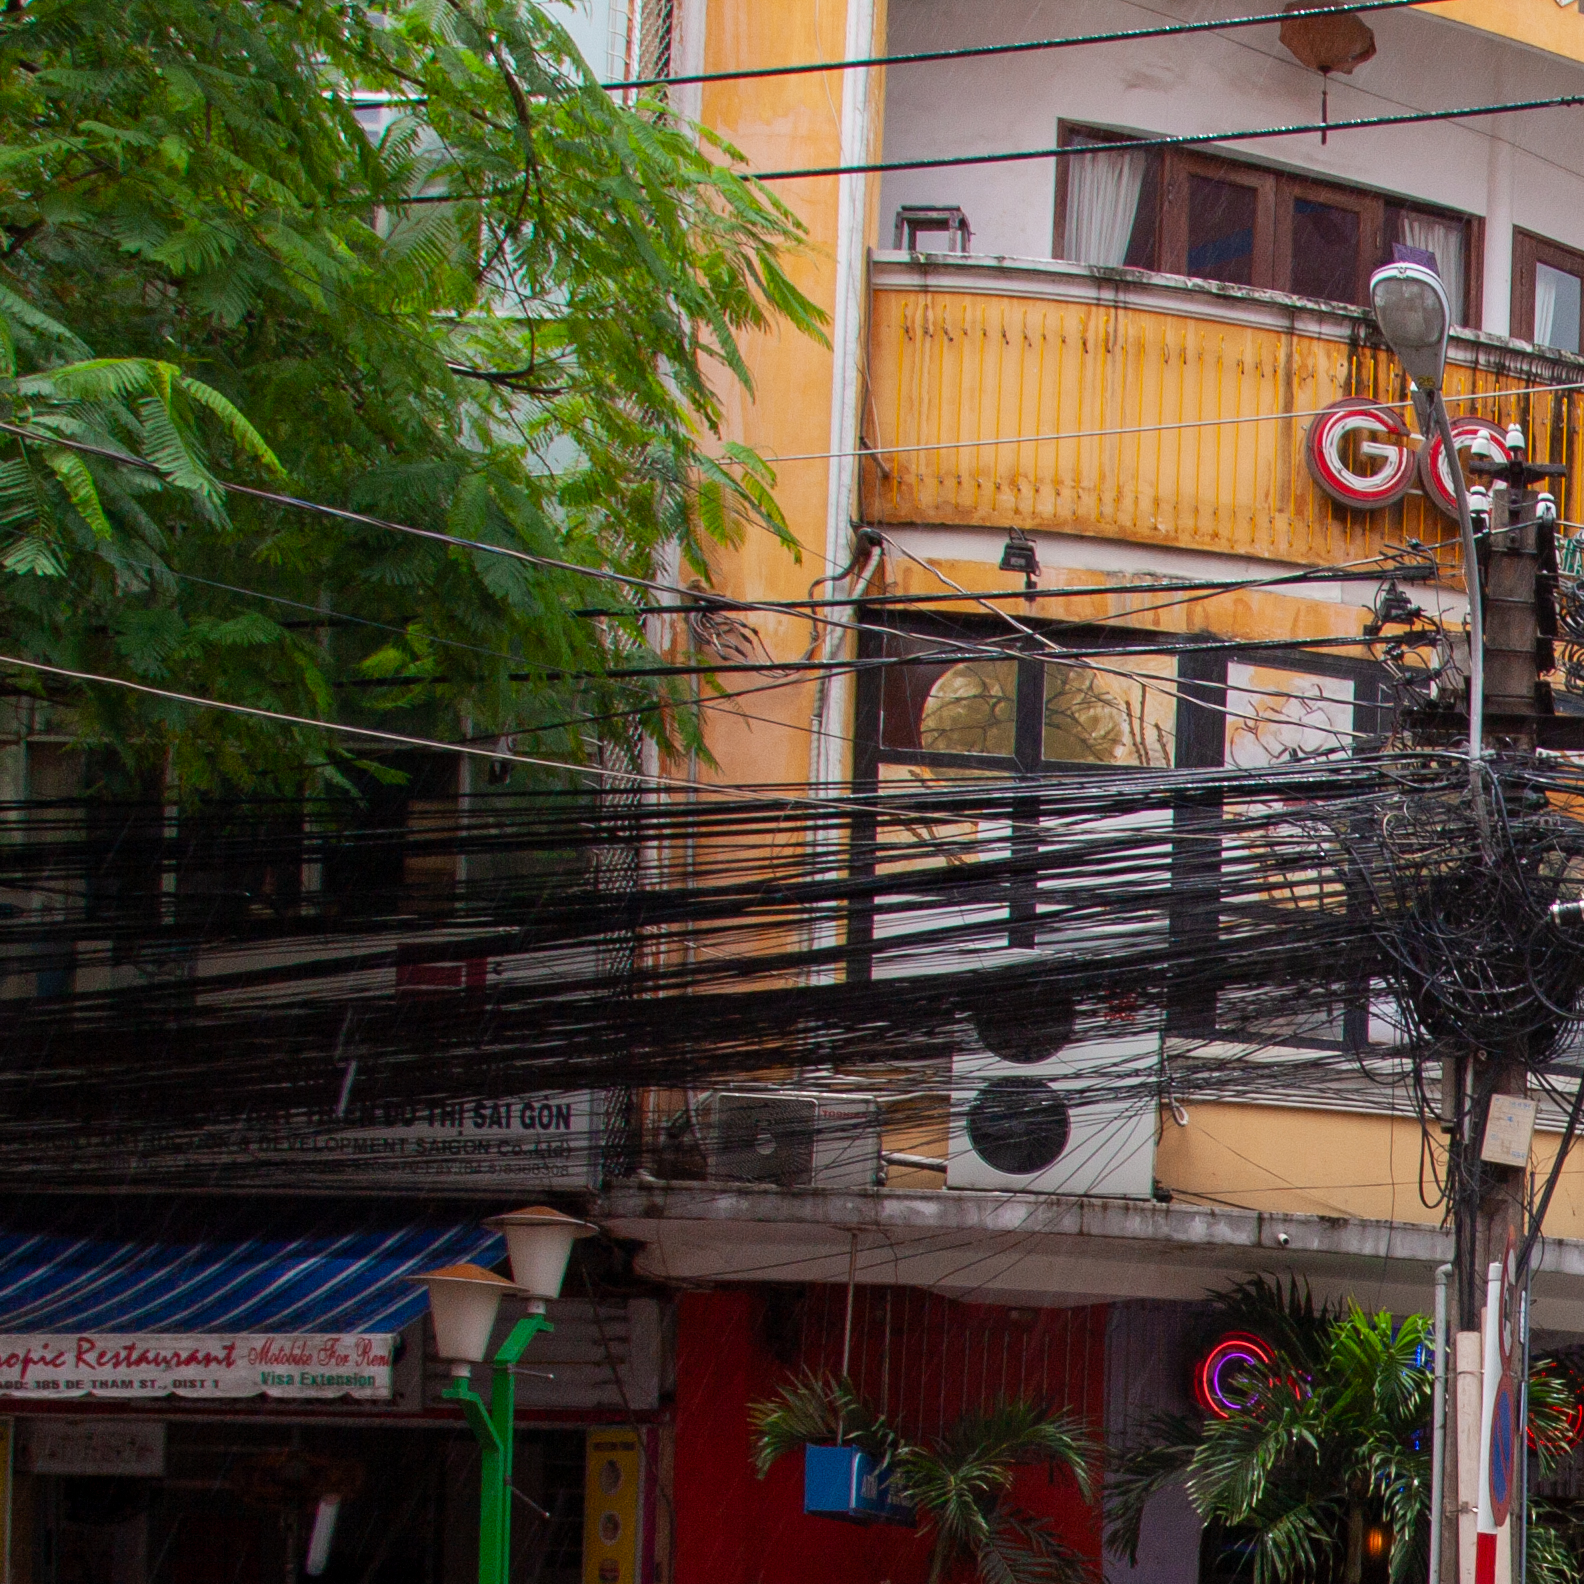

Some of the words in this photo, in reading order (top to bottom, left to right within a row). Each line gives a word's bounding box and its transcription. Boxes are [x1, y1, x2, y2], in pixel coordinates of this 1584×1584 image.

[75, 1336, 237, 1371] Restaurant
[92, 1380, 135, 1390] THAM
[261, 1371, 294, 1387] Visa
[299, 1371, 377, 1388] Extension
